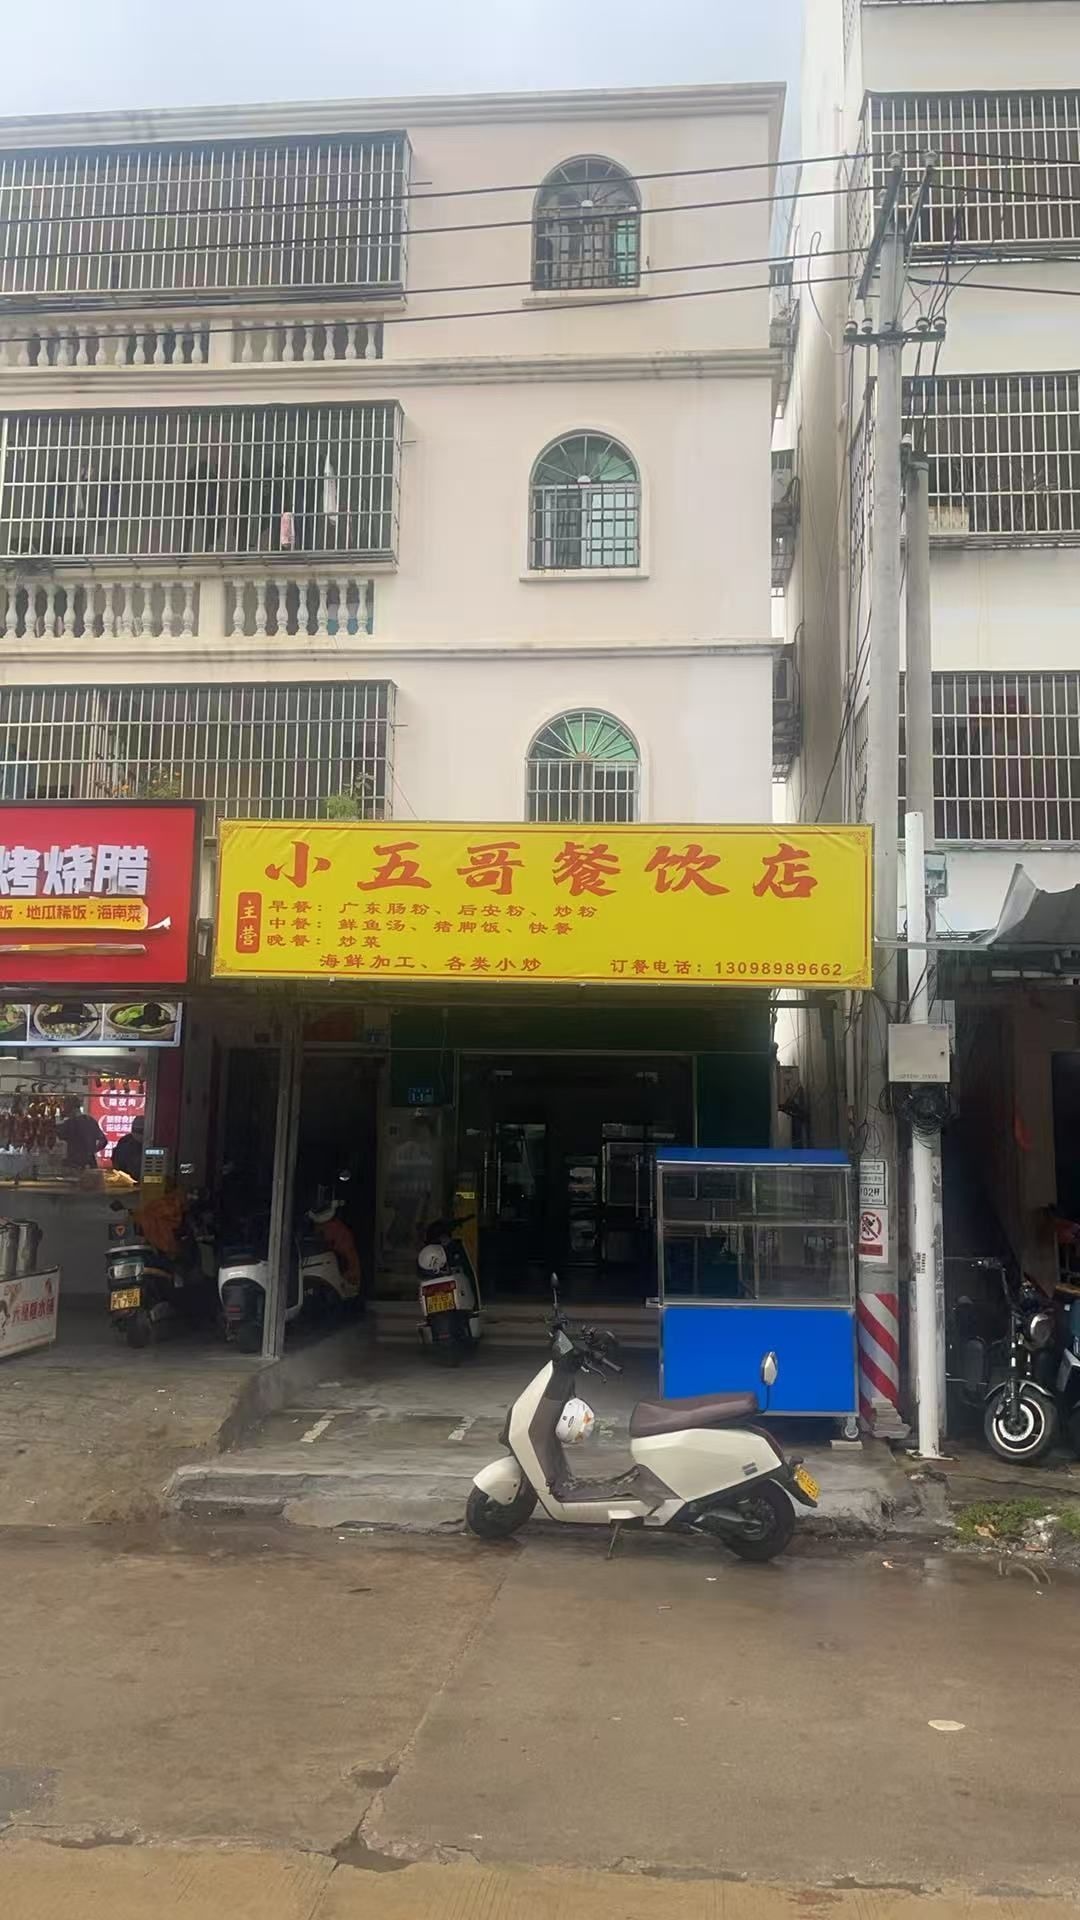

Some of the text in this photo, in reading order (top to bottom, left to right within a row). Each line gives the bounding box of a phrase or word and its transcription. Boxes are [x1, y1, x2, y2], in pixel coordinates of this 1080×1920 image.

[0, 844, 149, 896] 烤烧腊
[265, 841, 818, 899] 小五哥餐饮店
[238, 901, 259, 947] 主营
[319, 953, 542, 973] 海鲜加工、各类小炒
